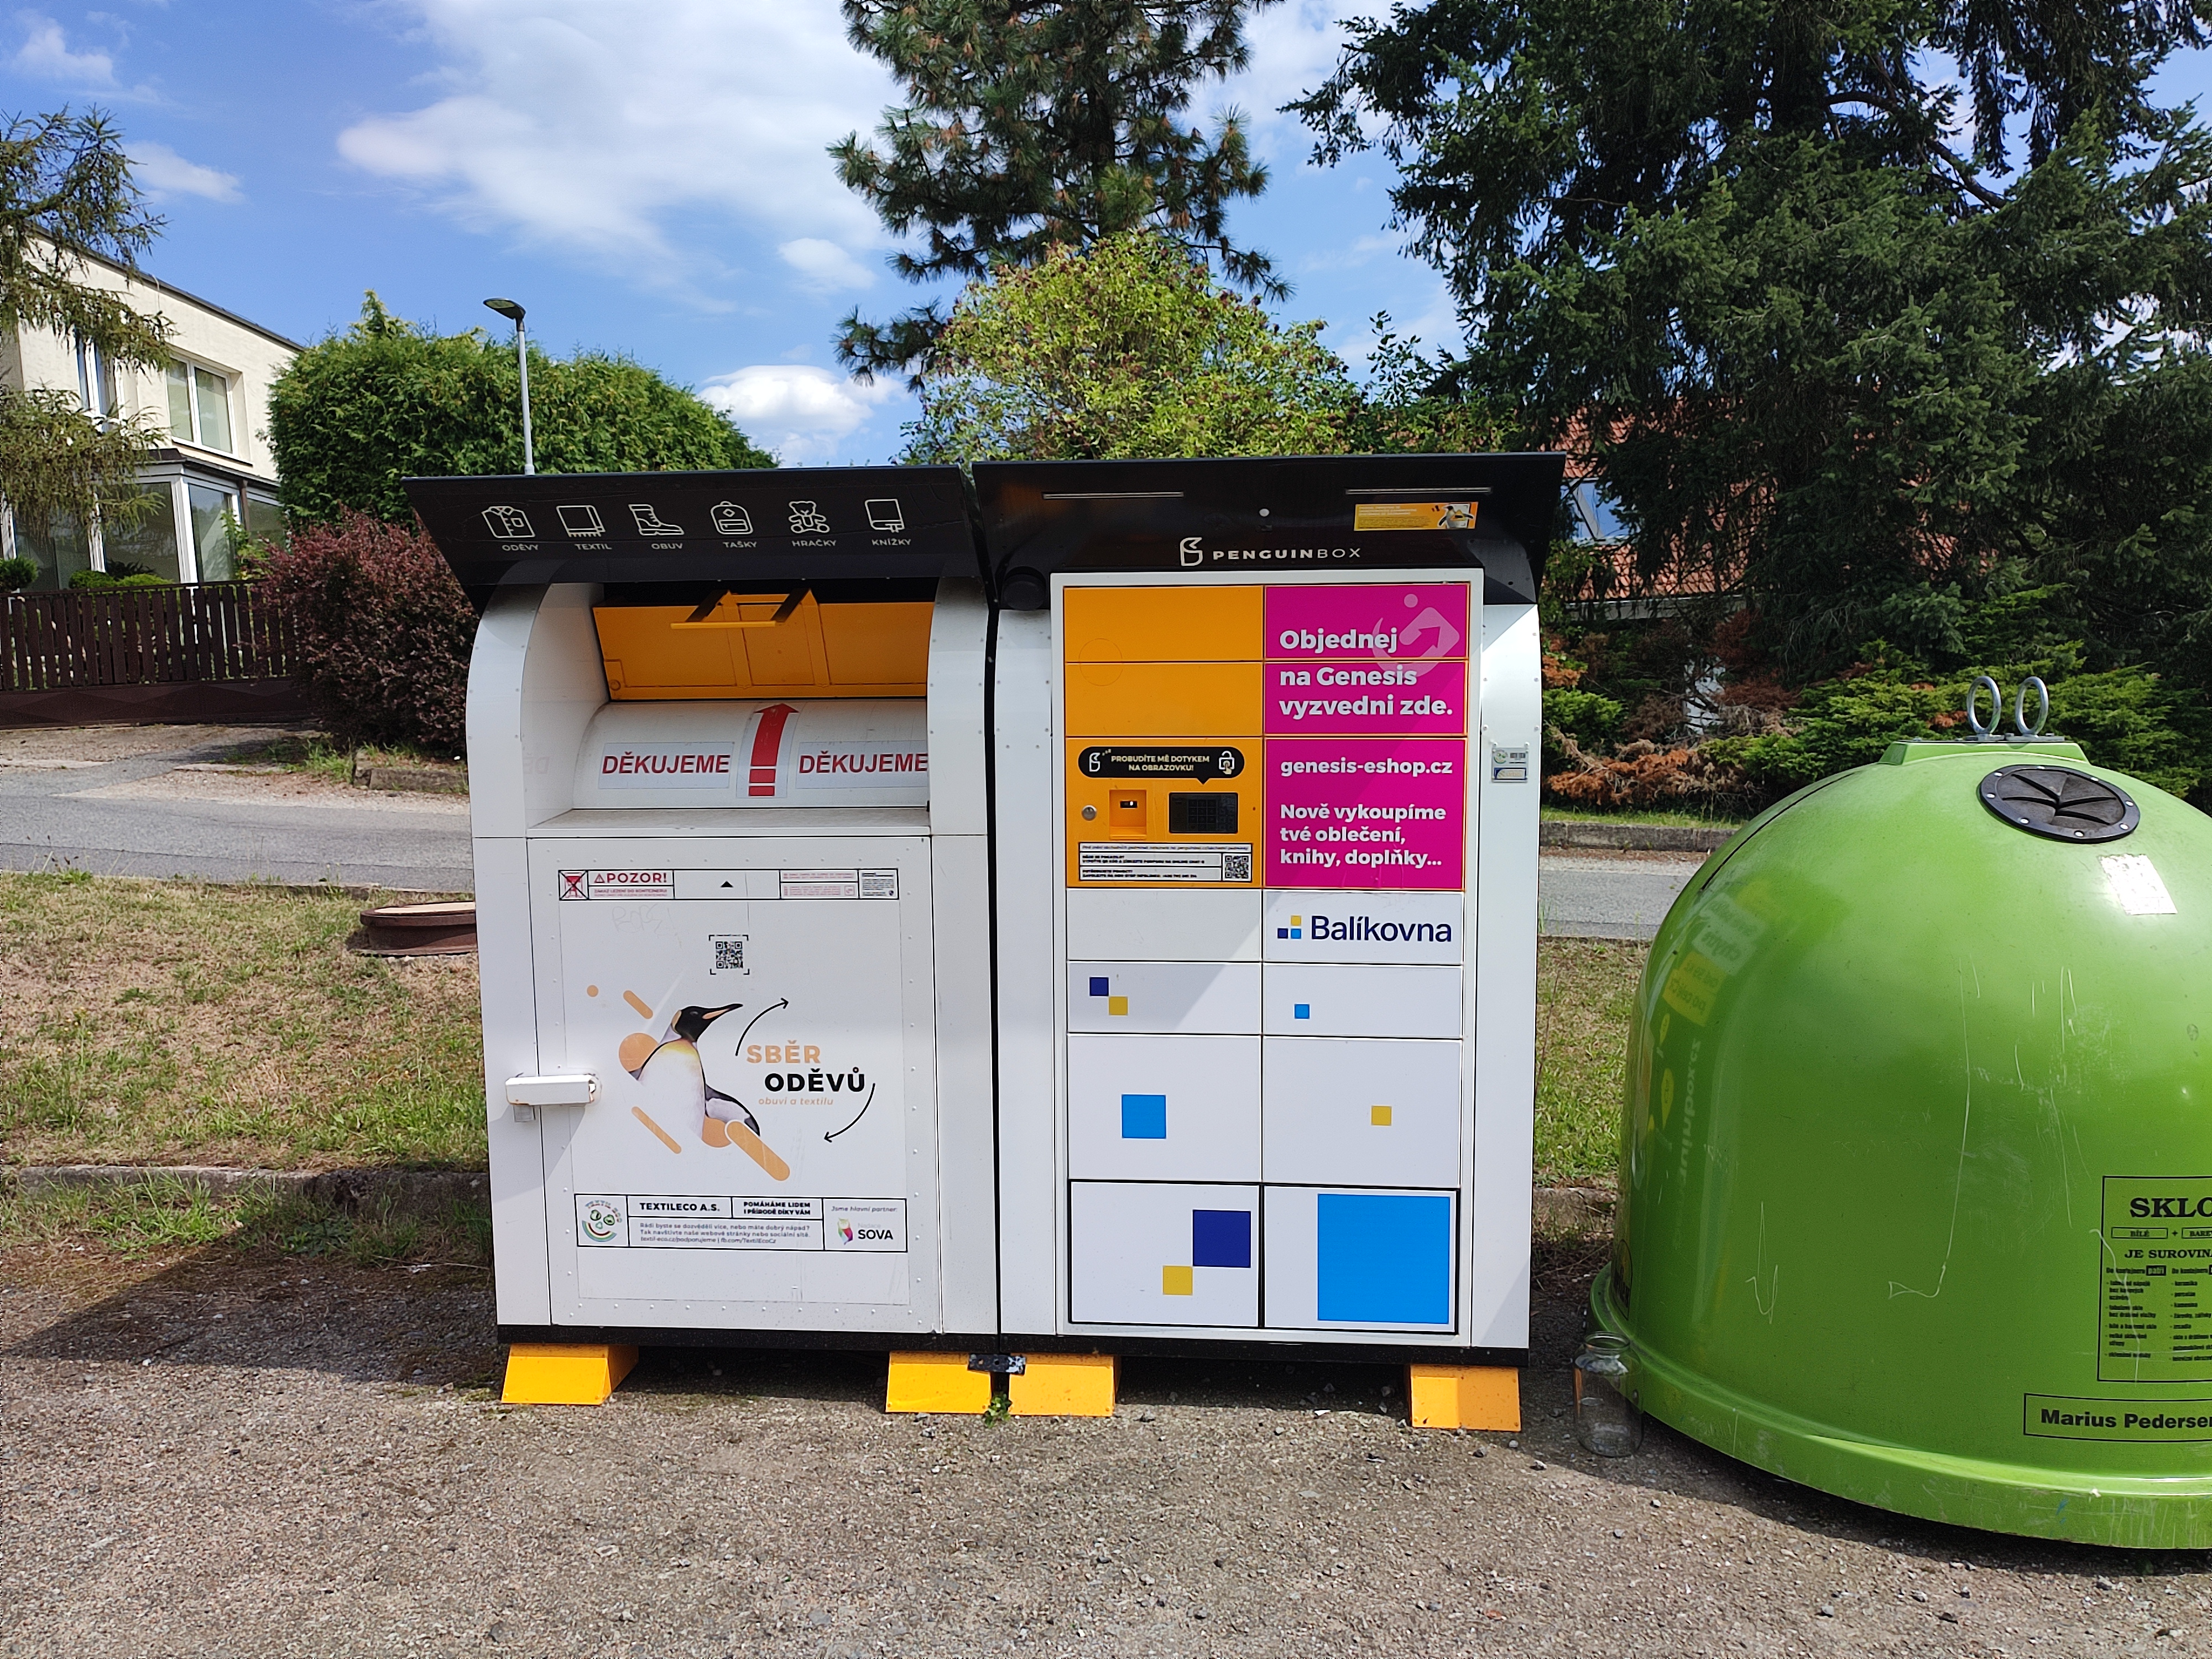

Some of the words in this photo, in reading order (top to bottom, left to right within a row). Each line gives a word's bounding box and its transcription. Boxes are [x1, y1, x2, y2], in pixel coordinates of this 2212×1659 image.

[502, 542, 539, 551] ODĚVY
[1213, 547, 1361, 560] PENGUINBOX
[1280, 627, 1397, 654] Objednej
[1280, 670, 1311, 686] na
[1316, 664, 1417, 686] Genesis
[1279, 693, 1394, 719] vyzvedni
[1400, 695, 1453, 715] zde.
[602, 752, 731, 774] DĚKUJEME
[799, 751, 929, 774] DĚKUJEME
[1157, 754, 1170, 762] MĚ
[1280, 757, 1453, 777] genesis-eshop.cz
[1280, 803, 1331, 820] Nově
[1333, 804, 1447, 823] vykoupíme
[1280, 826, 1312, 841] tvé
[1315, 826, 1406, 845] oblečení,
[1280, 848, 1342, 868] knihy,
[1344, 848, 1442, 869] doplňky...
[606, 872, 667, 884] POZOR!
[1311, 915, 1452, 942] Balíkovna
[746, 1040, 821, 1064] SBĚR
[764, 1067, 865, 1093] ODĚVŮ
[800, 1097, 834, 1105] textilu
[639, 1202, 697, 1211] TEXTILECO
[700, 1203, 721, 1212] A.S.
[858, 1229, 894, 1240] SOVA
[2130, 1229, 2150, 1237] BÍLÉ
[2124, 1249, 2144, 1258] JE
[2148, 1249, 2212, 1259] SUROVIN
[2041, 1408, 2117, 1428] Marius
